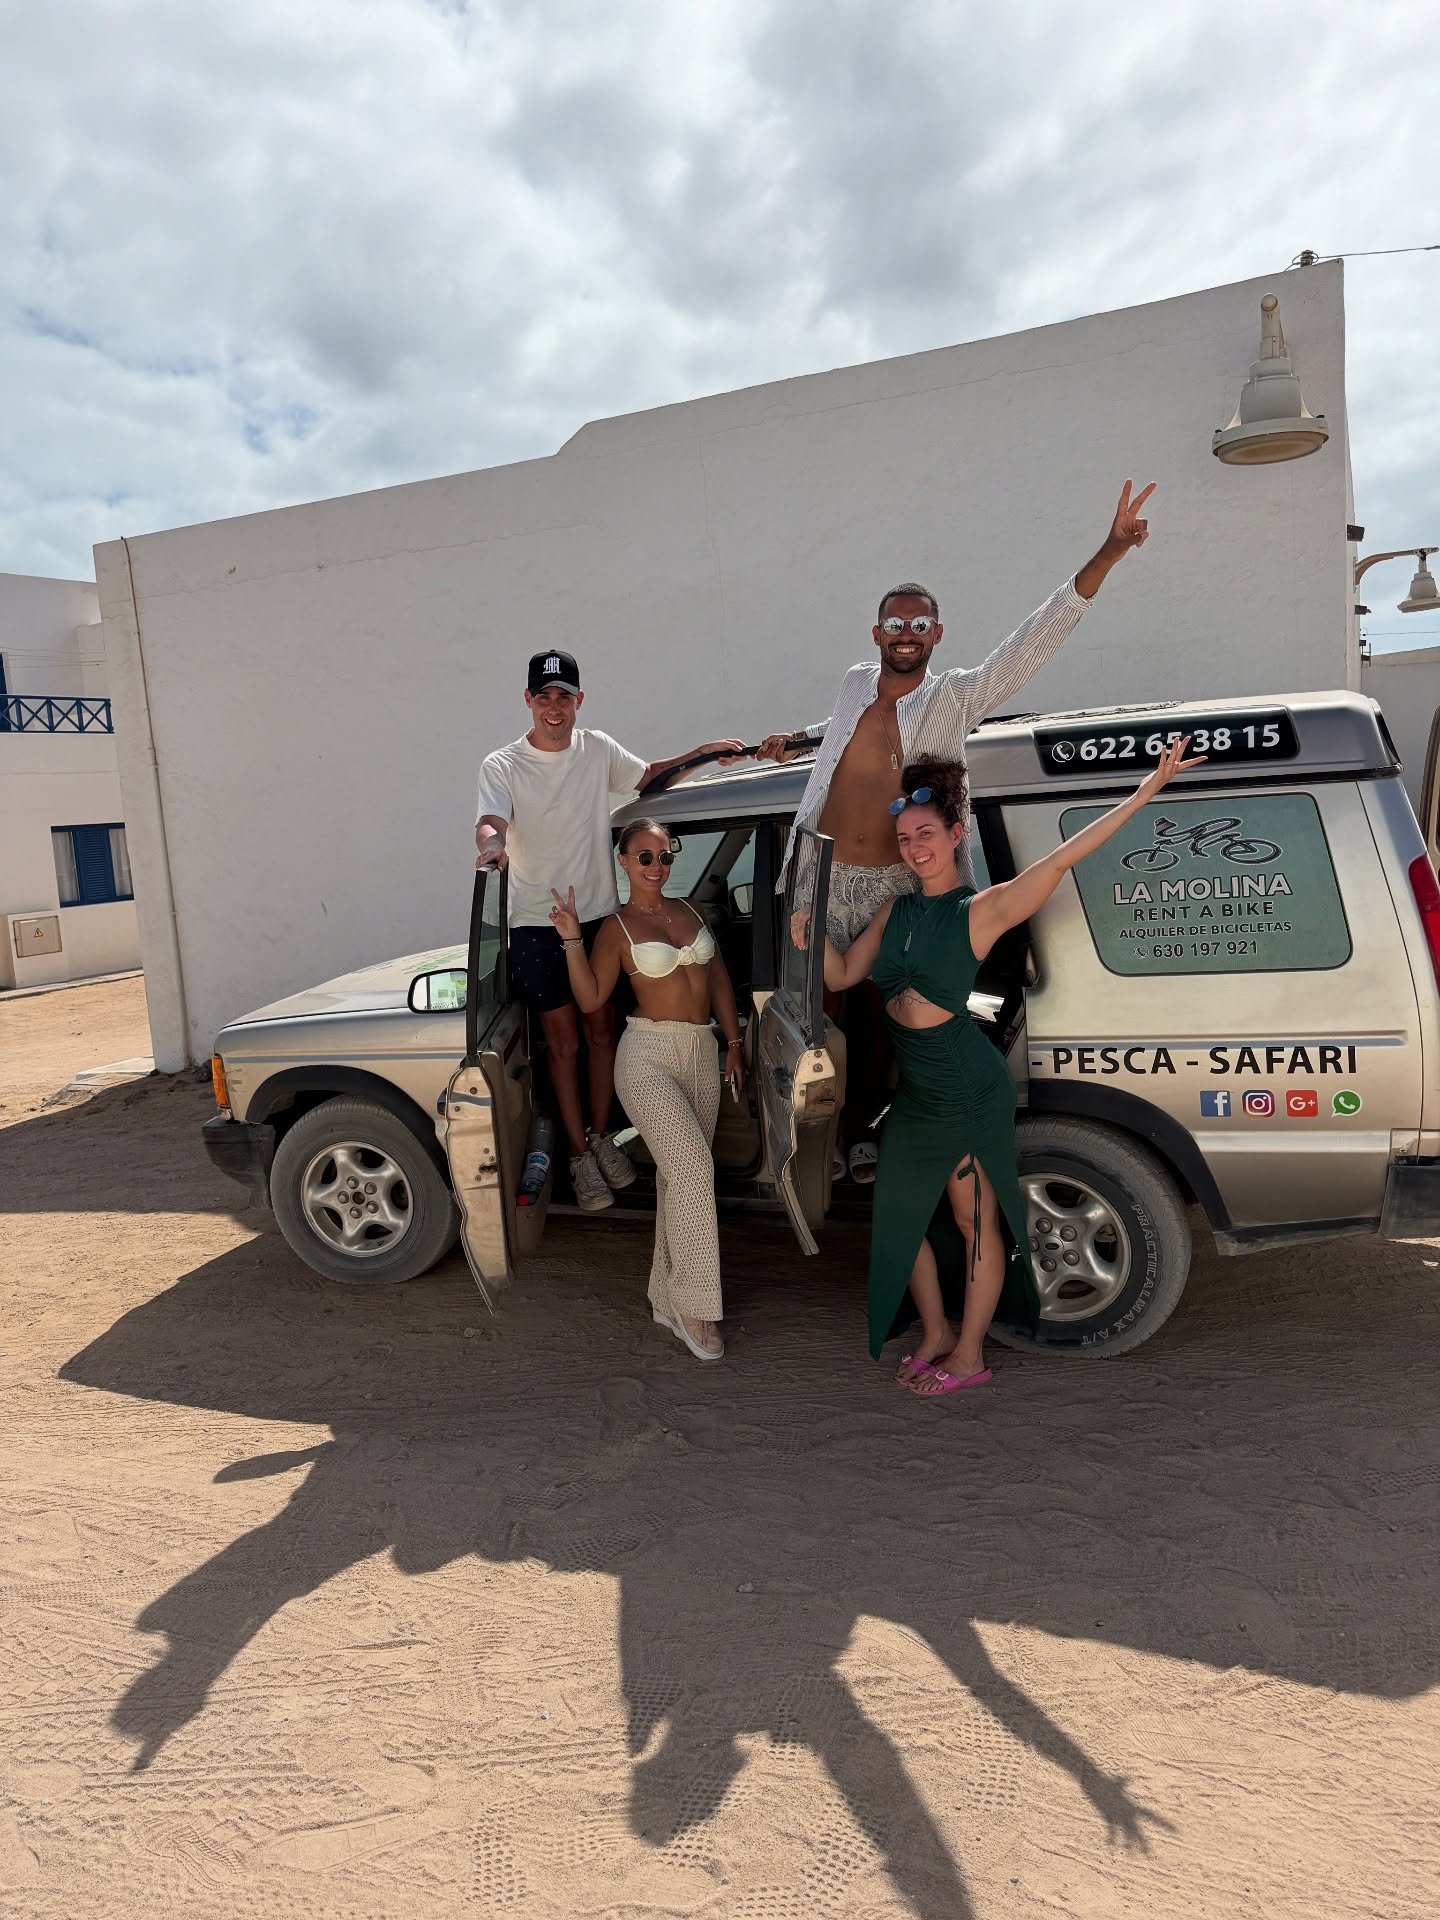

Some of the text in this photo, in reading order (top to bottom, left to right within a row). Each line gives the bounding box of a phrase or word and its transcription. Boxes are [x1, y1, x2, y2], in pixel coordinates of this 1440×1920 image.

[1080, 724, 1280, 761] 622 65 38 15
[1113, 872, 1293, 905] LA MOLINA
[1133, 901, 1274, 922] RENT A BIKE
[1119, 921, 1292, 940] ALQUILER DE BICICLETAS
[1153, 940, 1258, 958] 630 197 921
[1052, 1047, 1177, 1075] PESCA
[1208, 1045, 1357, 1075] SAFARI
